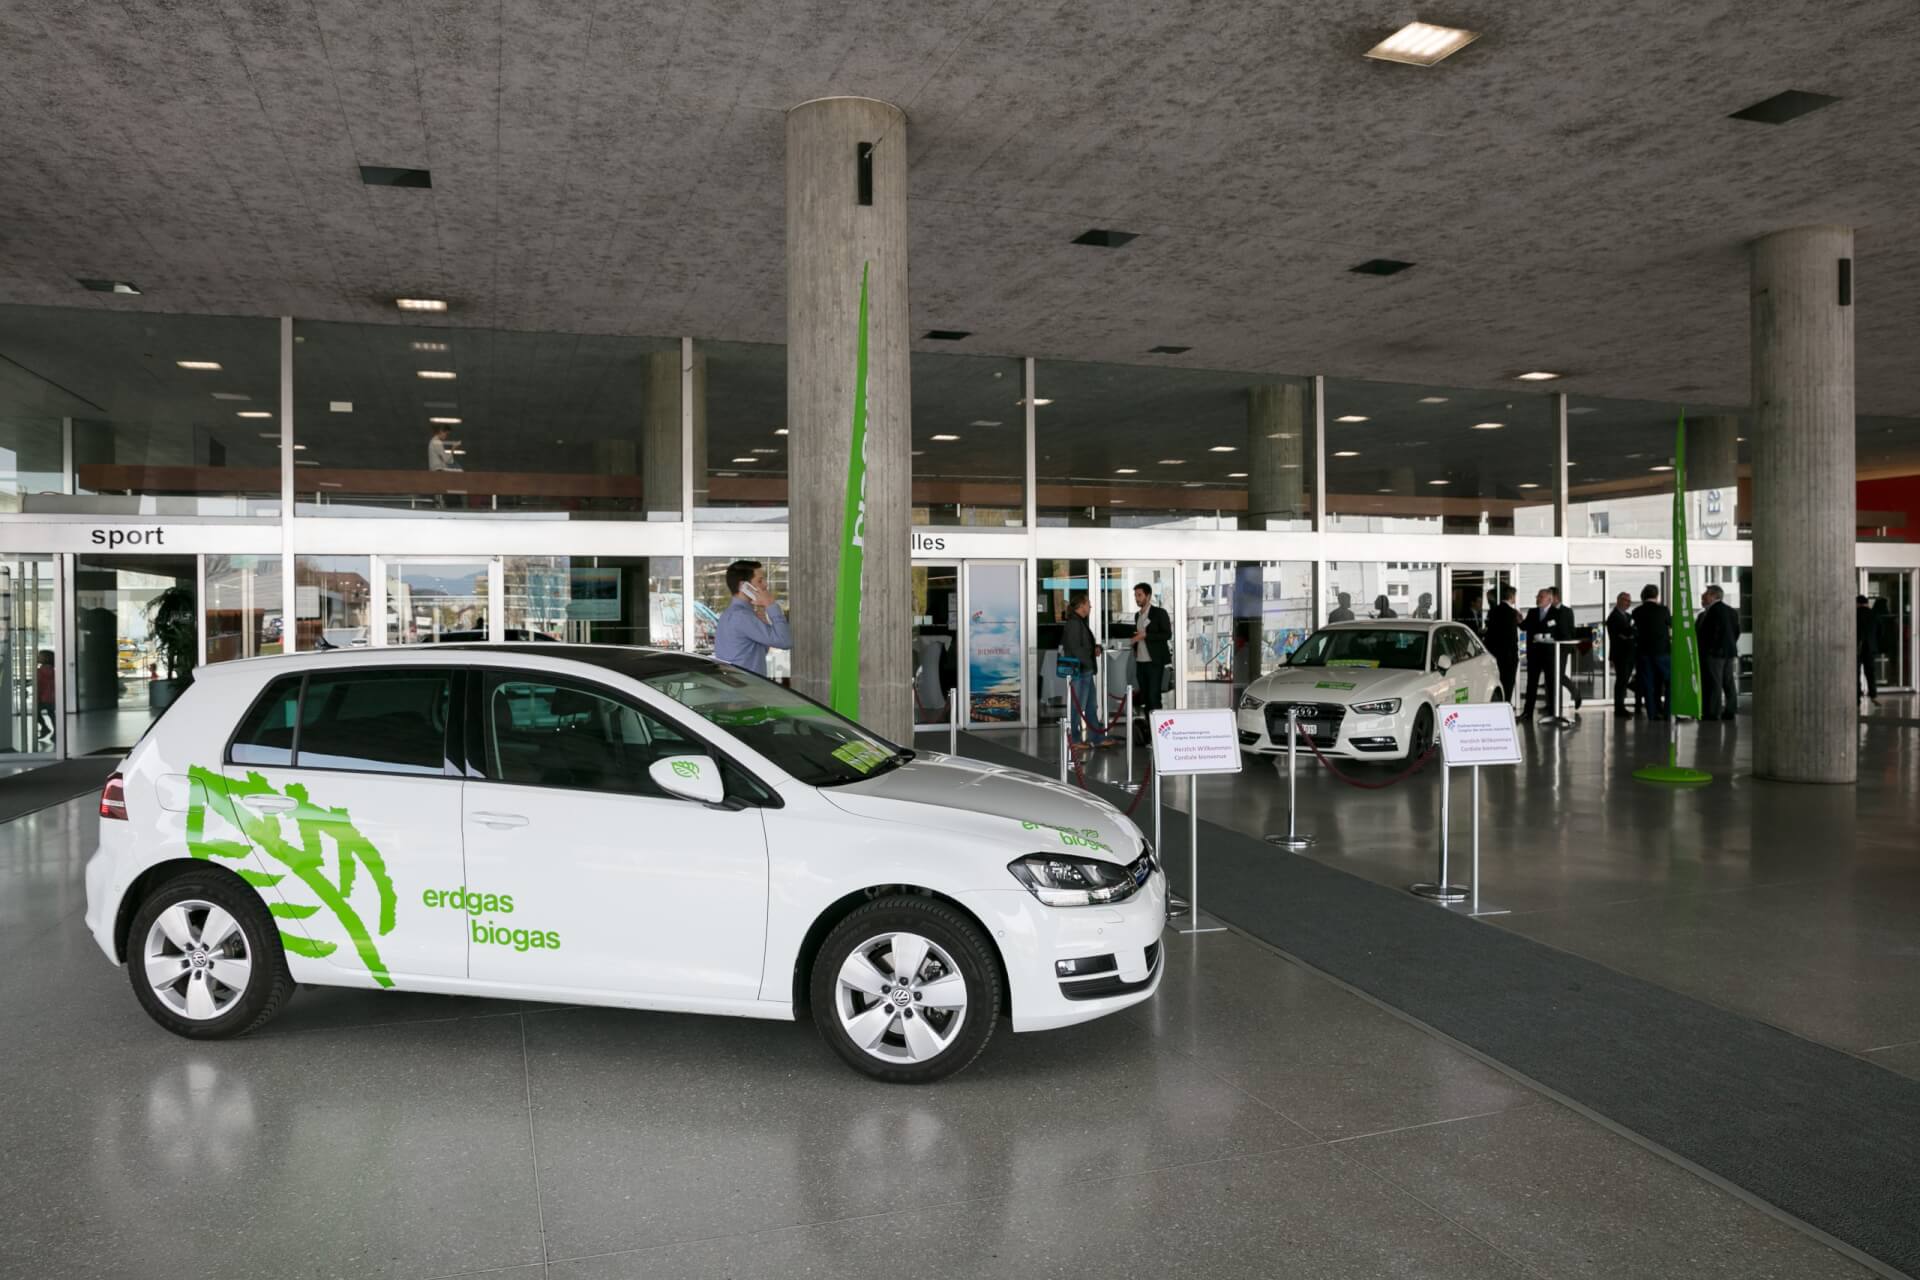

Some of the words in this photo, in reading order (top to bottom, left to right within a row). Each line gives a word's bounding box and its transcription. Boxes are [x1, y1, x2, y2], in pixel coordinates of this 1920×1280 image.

[91, 526, 165, 550] sport
[1624, 544, 1663, 560] salles
[422, 886, 514, 916] erdgas
[471, 919, 561, 952] biogas
